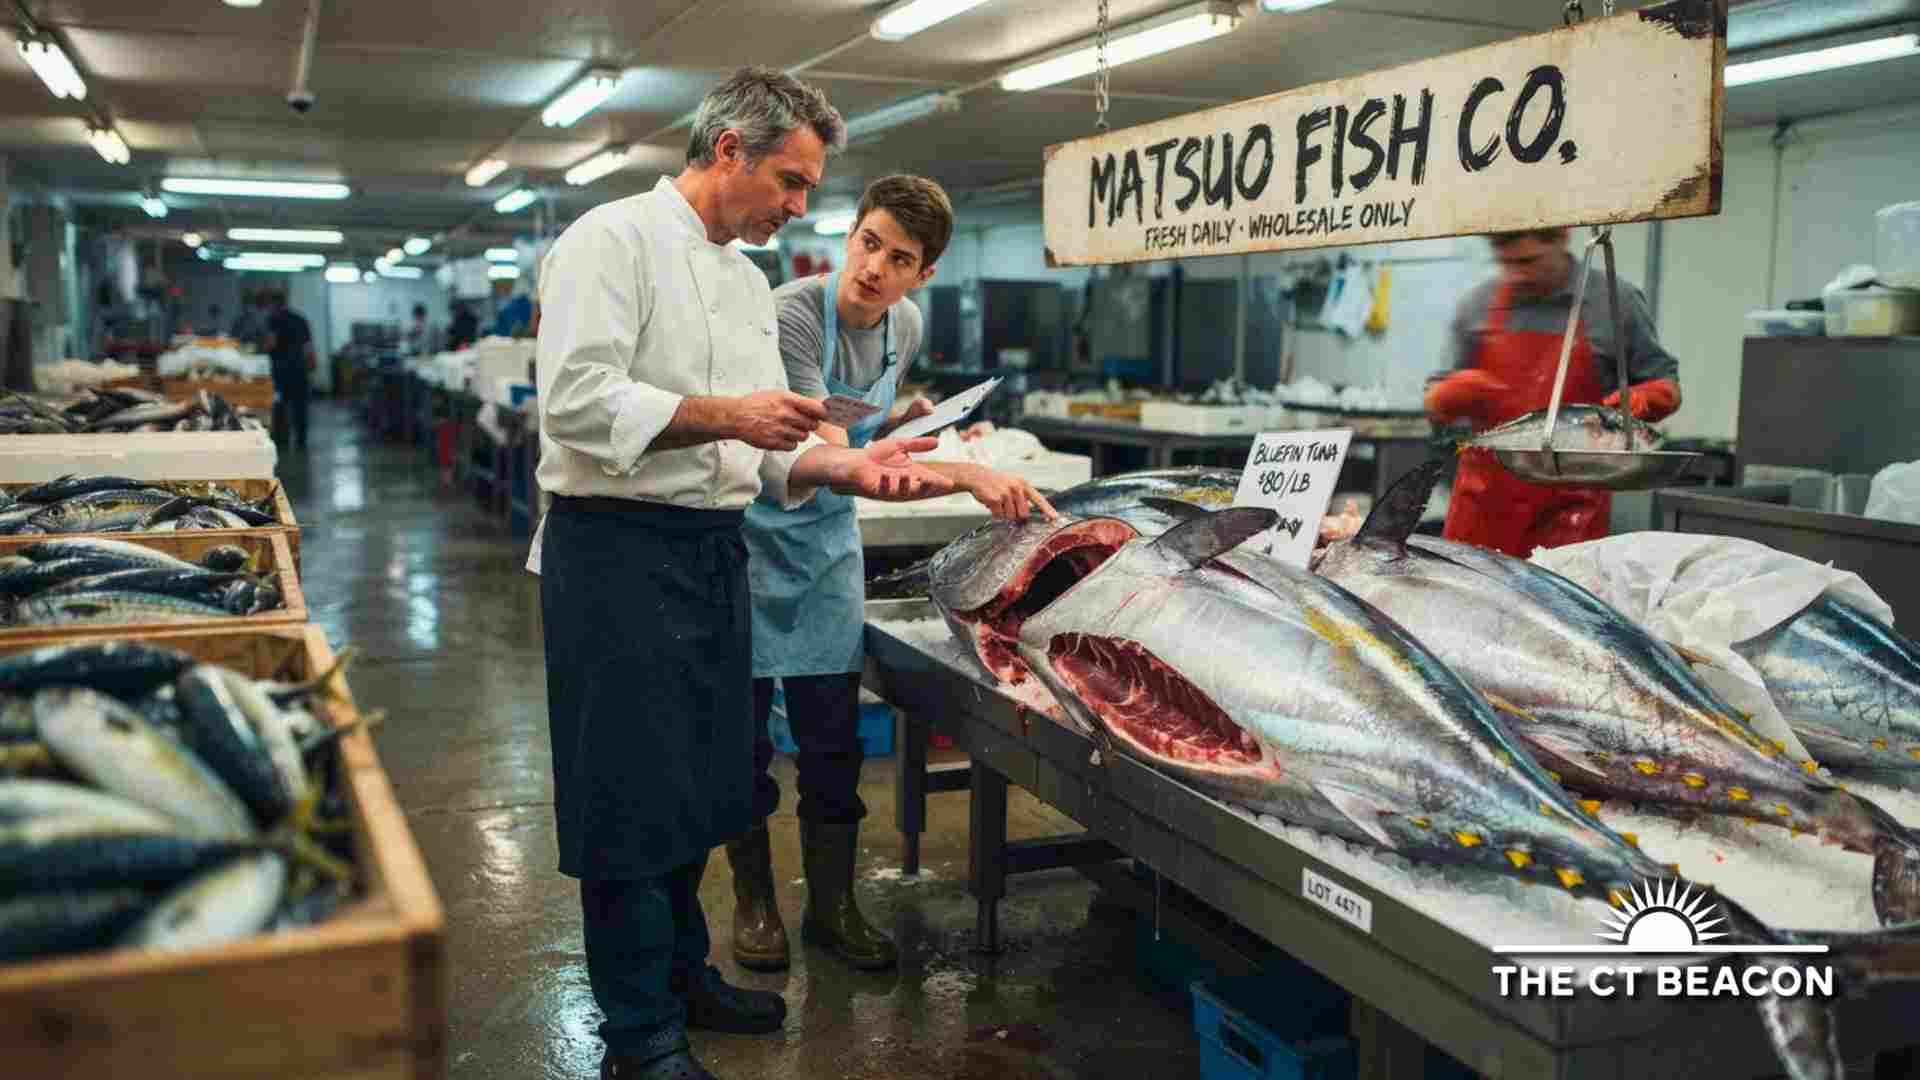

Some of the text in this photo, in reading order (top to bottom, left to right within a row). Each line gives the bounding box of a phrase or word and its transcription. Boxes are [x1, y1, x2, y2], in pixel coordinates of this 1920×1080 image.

[1088, 64, 1578, 229] MATSUO FISH CO.
[1144, 227, 1188, 251] FRESH
[1191, 219, 1236, 246] DAILY
[1248, 206, 1353, 238] WHOLESALE
[1359, 197, 1416, 228] ONLY
[1253, 441, 1338, 465] BLUEFIN TUNA
[1258, 470, 1311, 498] $80/LB
[1308, 879, 1362, 919] LOT 4471
